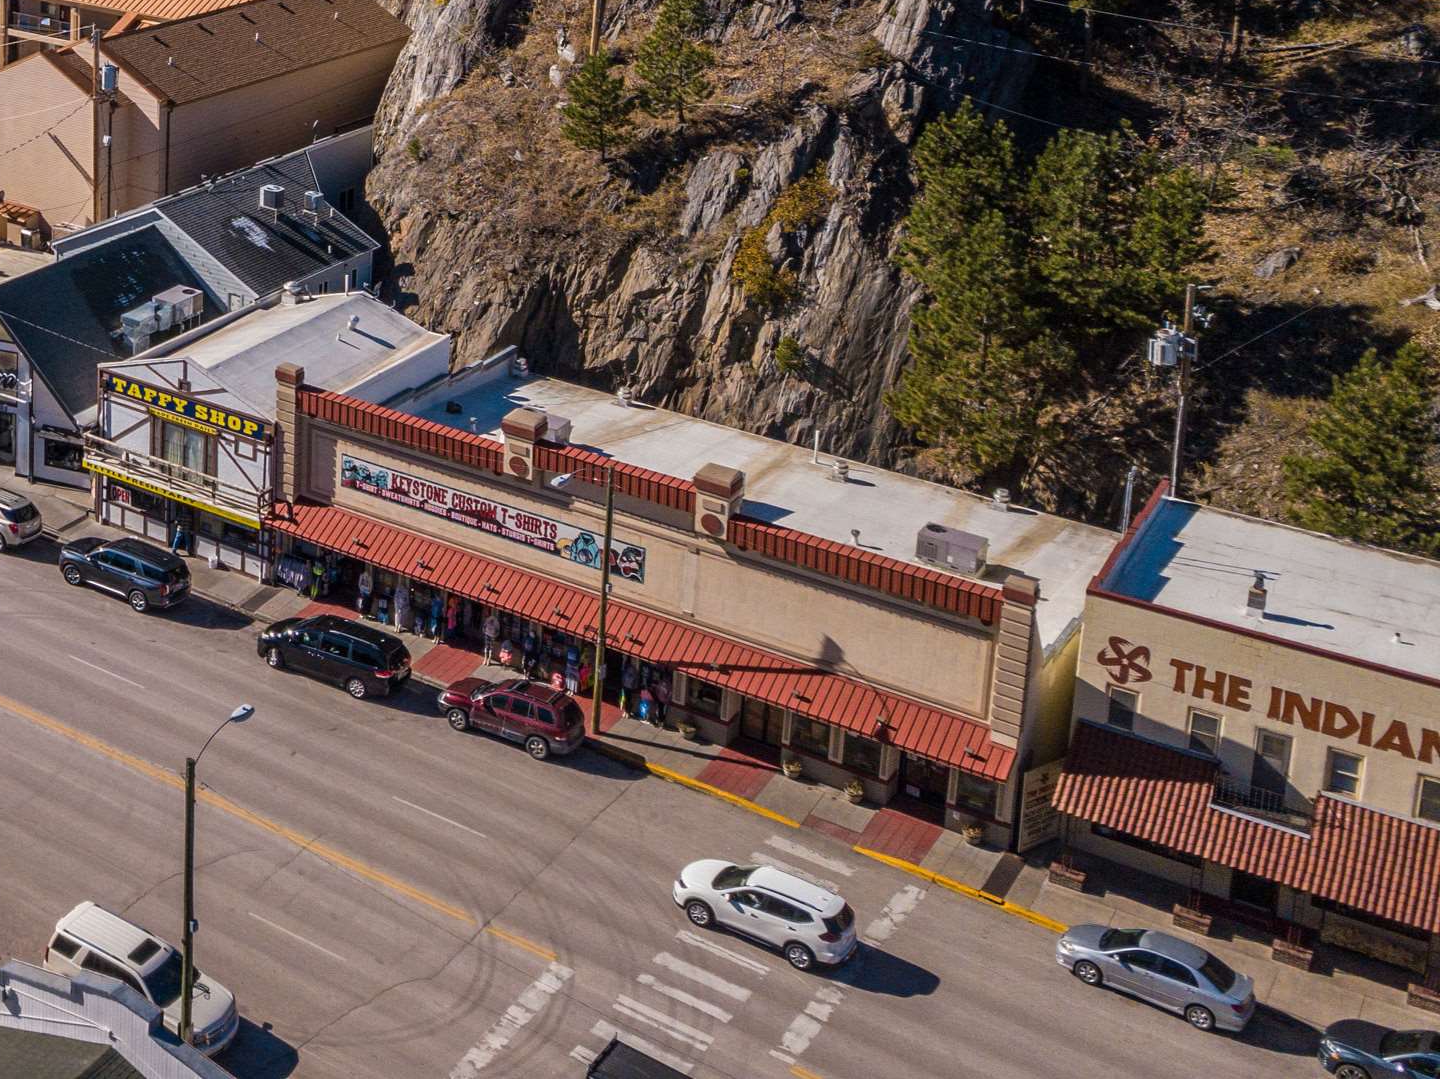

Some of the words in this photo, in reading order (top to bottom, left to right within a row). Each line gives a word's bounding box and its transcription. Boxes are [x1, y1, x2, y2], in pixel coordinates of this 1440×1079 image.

[113, 377, 188, 414] TAFFY
[195, 405, 259, 435] SHOP
[112, 487, 130, 503] OPEN
[126, 475, 160, 492] FRESH
[391, 473, 449, 506] KEYSTONE
[452, 492, 497, 520] CUSTOM
[501, 508, 558, 539] T-SHIRTS
[356, 480, 378, 493] T-SHIRT
[382, 489, 421, 507] SWEATSHIRTS
[451, 512, 478, 527] BOUTIQUE
[482, 522, 498, 533] HATS
[527, 535, 555, 550] T-SHIRTS
[1169, 658, 1252, 712] THE
